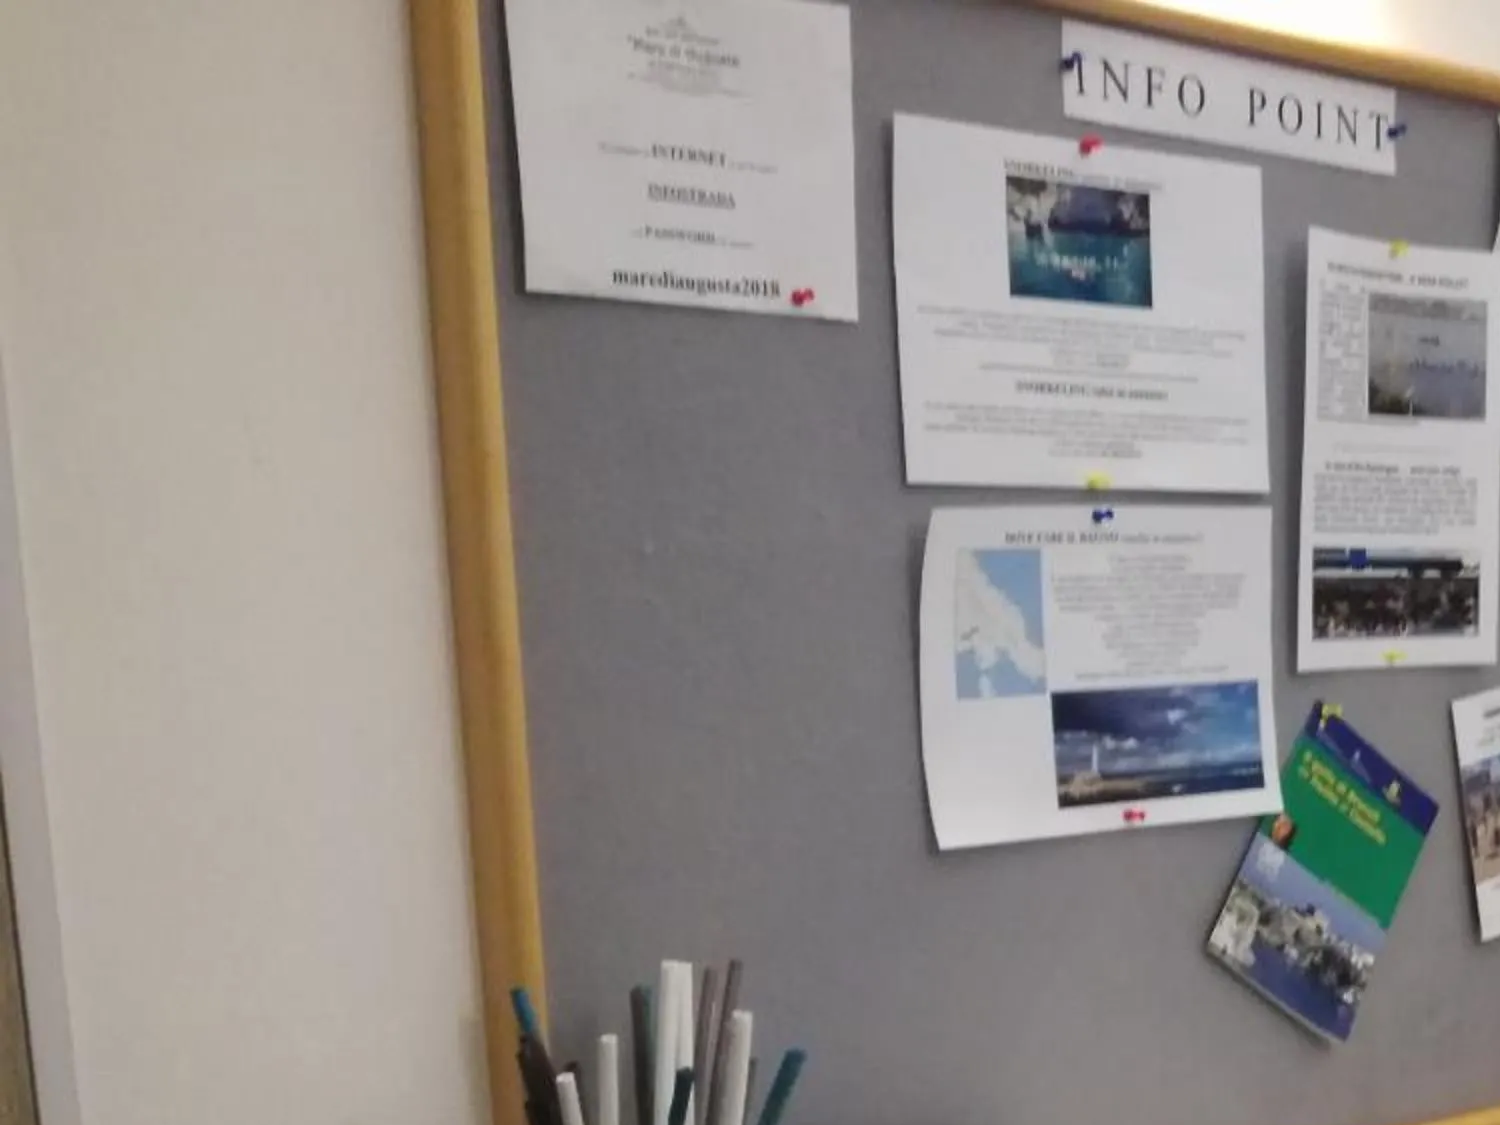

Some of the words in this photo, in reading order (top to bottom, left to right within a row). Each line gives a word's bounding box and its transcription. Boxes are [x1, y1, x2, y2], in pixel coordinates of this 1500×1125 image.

[1072, 53, 1206, 118] INFO
[1248, 86, 1389, 151] POINT
[652, 143, 727, 169] INTERNET
